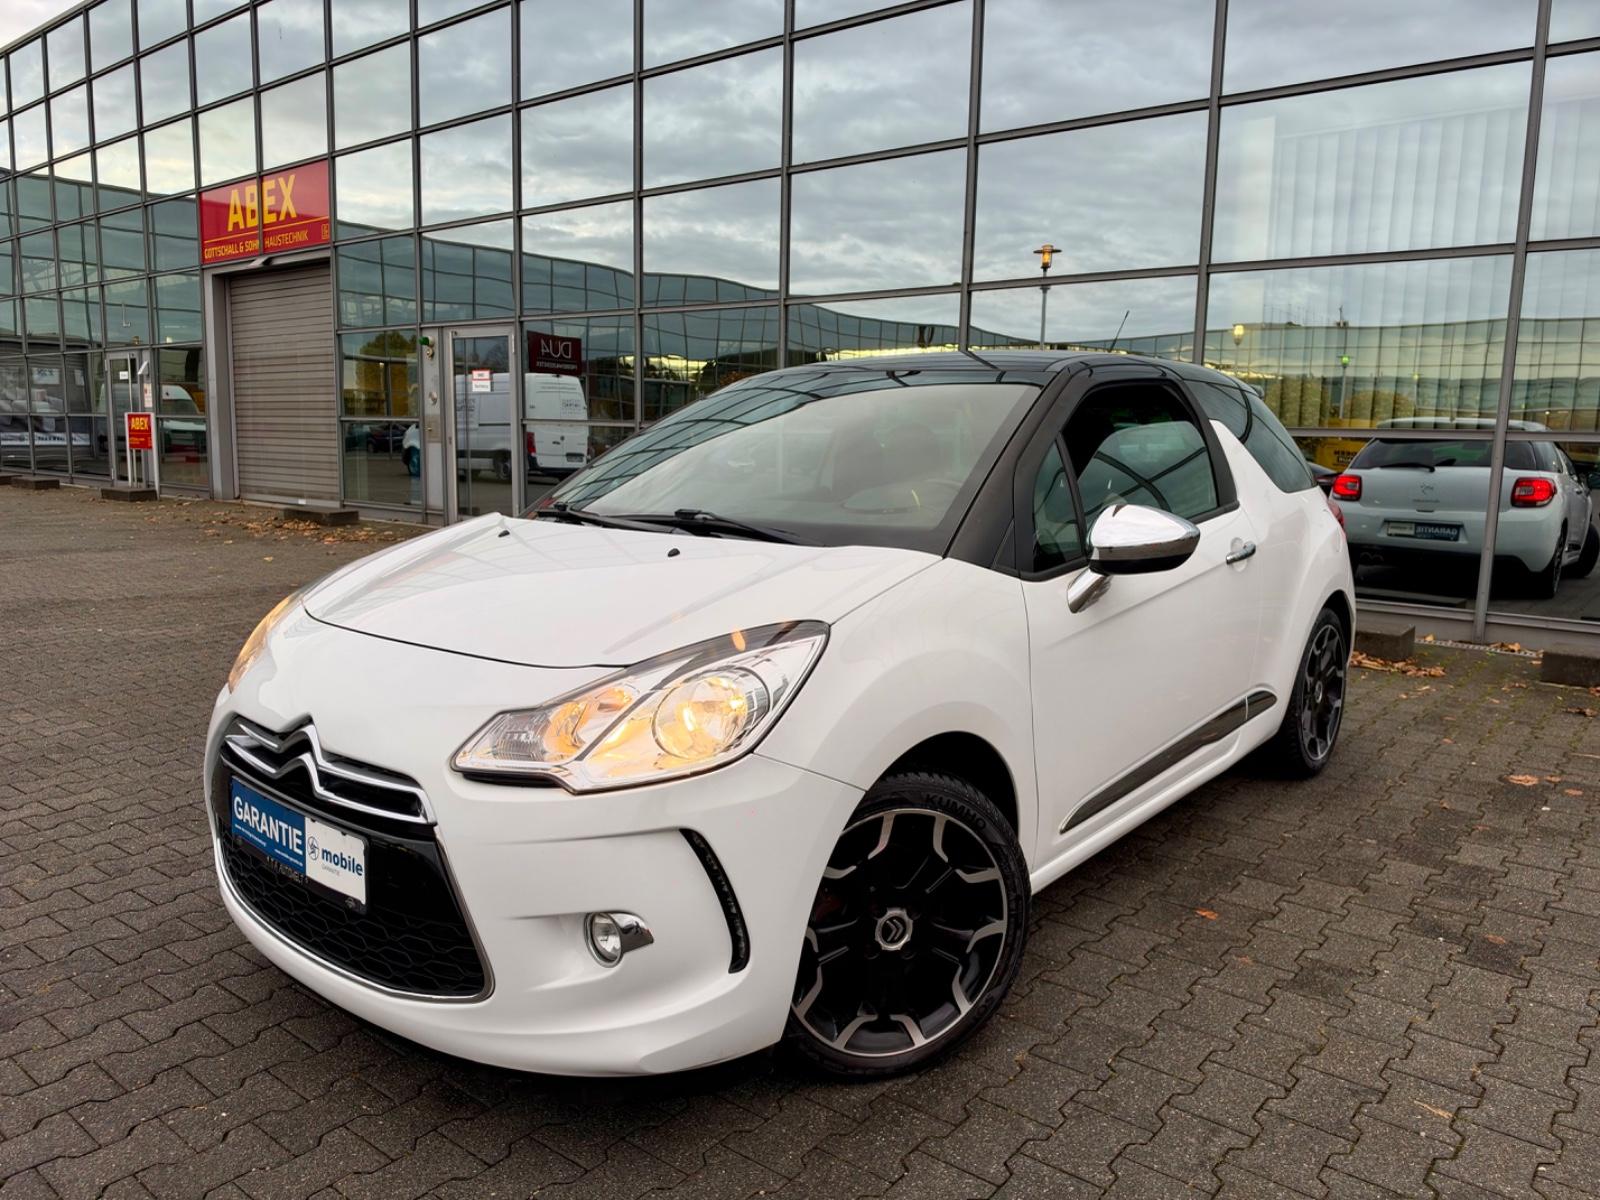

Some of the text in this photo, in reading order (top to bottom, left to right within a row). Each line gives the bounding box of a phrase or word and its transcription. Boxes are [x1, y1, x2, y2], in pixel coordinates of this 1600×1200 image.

[227, 174, 297, 232] ABEX
[204, 244, 239, 259] GOTTSCHALL
[264, 230, 309, 248] HAUSTECHNIK
[130, 417, 149, 431] ABEX
[233, 796, 304, 856] GARANTIE
[925, 793, 986, 830] KUMHO
[321, 847, 364, 877] mobile
